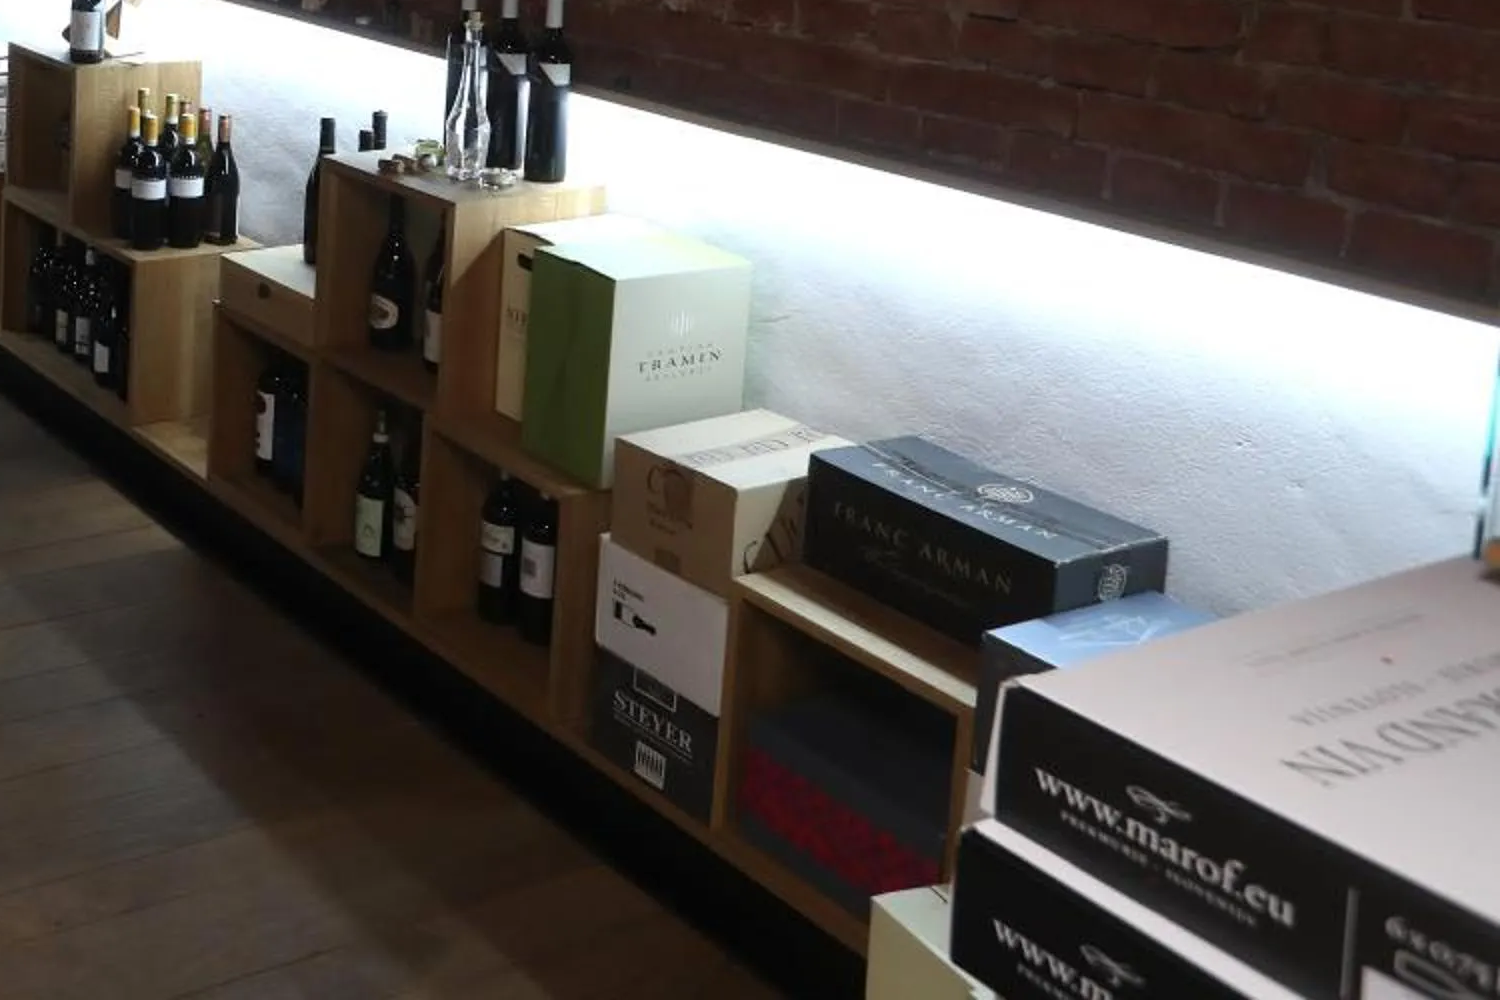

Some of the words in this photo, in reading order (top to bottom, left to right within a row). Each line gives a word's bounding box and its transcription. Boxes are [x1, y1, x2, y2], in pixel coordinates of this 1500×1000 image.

[833, 500, 910, 548] FRANC
[918, 543, 1014, 595] ARMAN
[612, 688, 694, 753] STEYER
[1033, 766, 1297, 929] www.marof.eu
